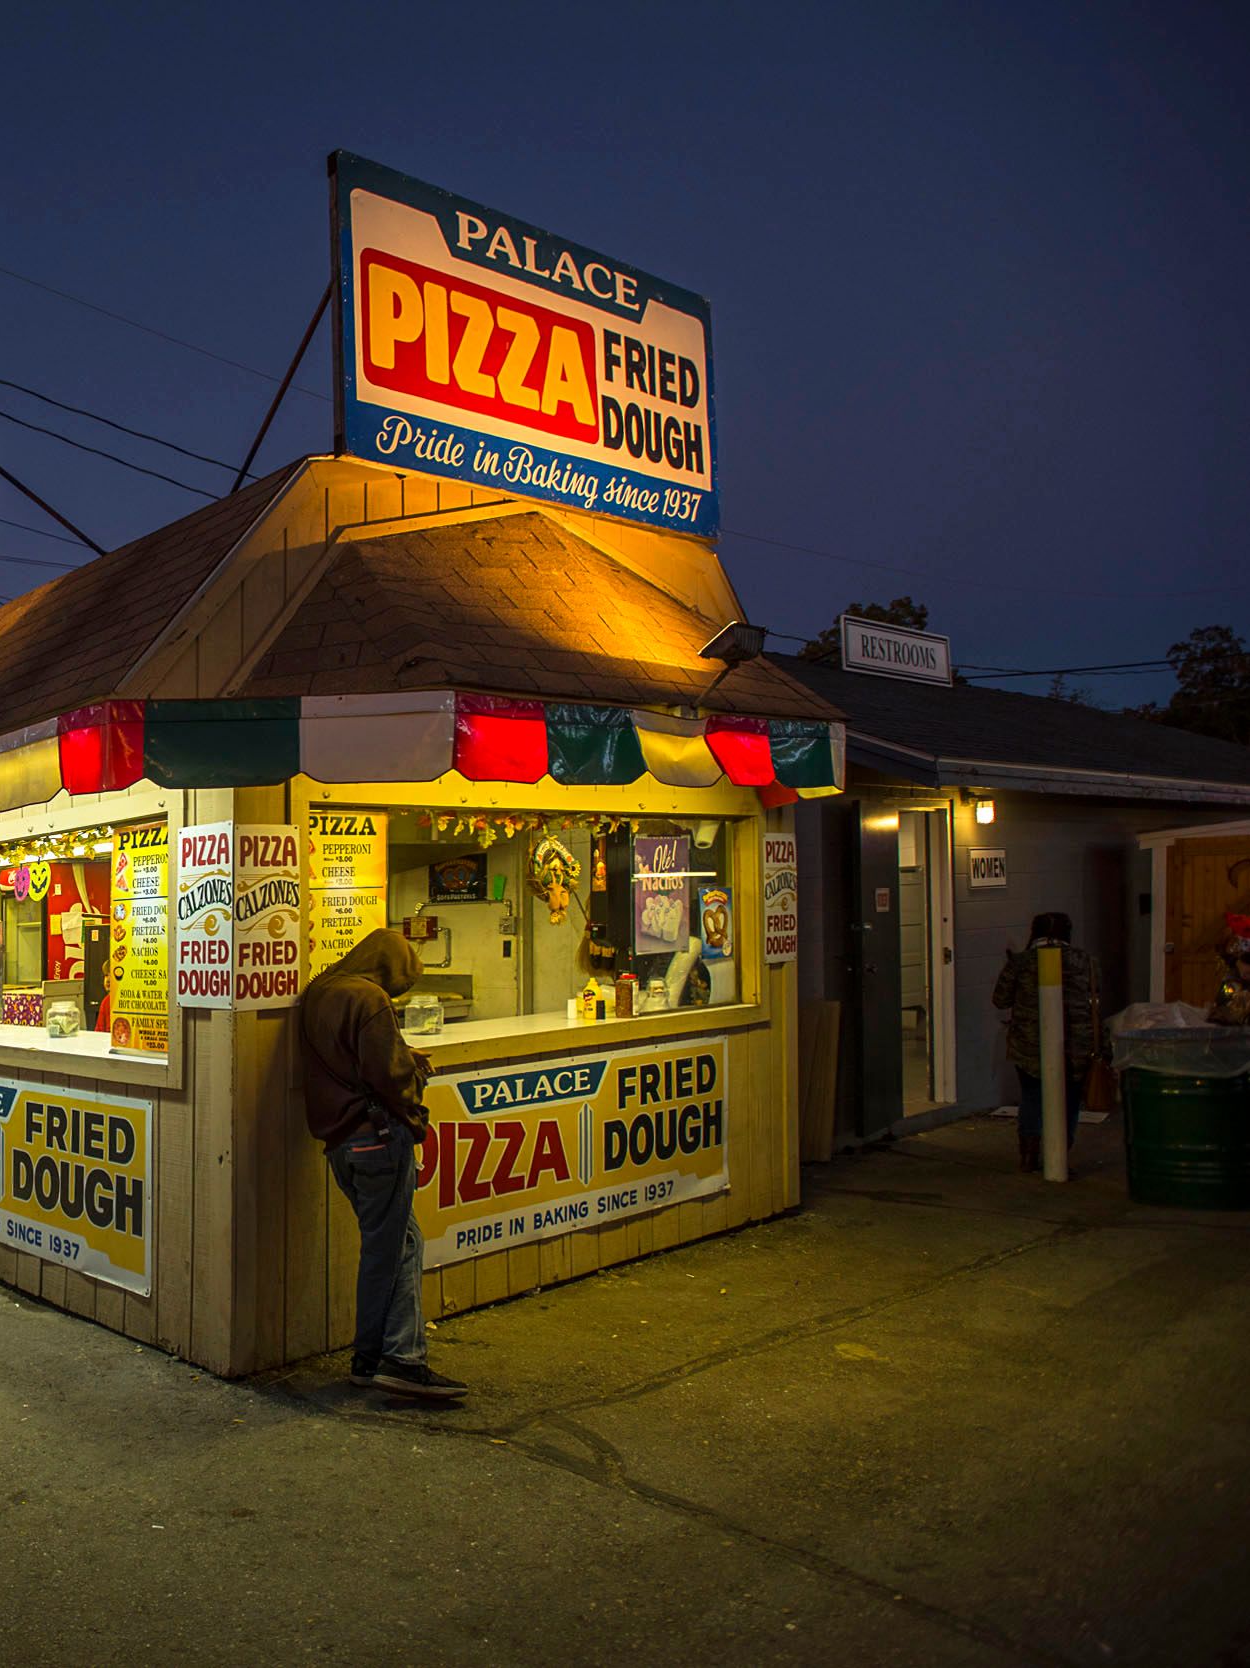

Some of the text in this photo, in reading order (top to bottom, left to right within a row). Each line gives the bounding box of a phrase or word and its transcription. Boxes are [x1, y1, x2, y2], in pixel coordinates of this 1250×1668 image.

[455, 210, 640, 311] PALACE
[368, 263, 596, 426] PIZZA
[603, 328, 700, 409] FRIED
[601, 394, 705, 475] DOUGH
[376, 416, 702, 522] Pride in Baking since 1937
[860, 634, 937, 671] RESTROOMS
[181, 833, 230, 867] PIZZA
[239, 835, 298, 868] PIZZA
[322, 843, 371, 855] PEPPERONI
[766, 840, 795, 863] PIZZA
[322, 866, 356, 878] CHEESE
[971, 856, 1005, 878] WOMEN
[132, 876, 160, 889] CHEESE
[131, 906, 153, 916] FRIED
[178, 878, 231, 920] CALZONES
[236, 880, 300, 922] CALZONES
[322, 895, 377, 907] FRIED DOUGH
[131, 925, 166, 936] PRETZELS
[321, 916, 363, 928] PRETZELS
[767, 914, 796, 933] FRIED
[131, 946, 159, 957] NACHOS
[180, 940, 230, 965] FRIED
[238, 941, 298, 967] FRIED
[321, 938, 355, 950] NACHOS
[766, 935, 796, 955] DOUGH
[131, 969, 157, 980] CHEESE
[178, 969, 230, 997] DOUGH
[235, 970, 299, 1000] DOUGH
[118, 1000, 166, 1011] HOT CHOCOLATE
[120, 989, 136, 999] SODA
[142, 990, 163, 999] WATER
[132, 1017, 155, 1028] FAMILY
[473, 1069, 591, 1109] PALACE
[618, 1054, 717, 1110] FRIED
[25, 1101, 136, 1166] FRIED
[604, 1100, 723, 1172] DOUGH
[12, 1149, 143, 1238] DOUGH
[456, 1180, 675, 1249] PRIDE IN BAKING SINCE 1937
[7, 1220, 42, 1247] SINCE
[49, 1234, 80, 1261] 1937
